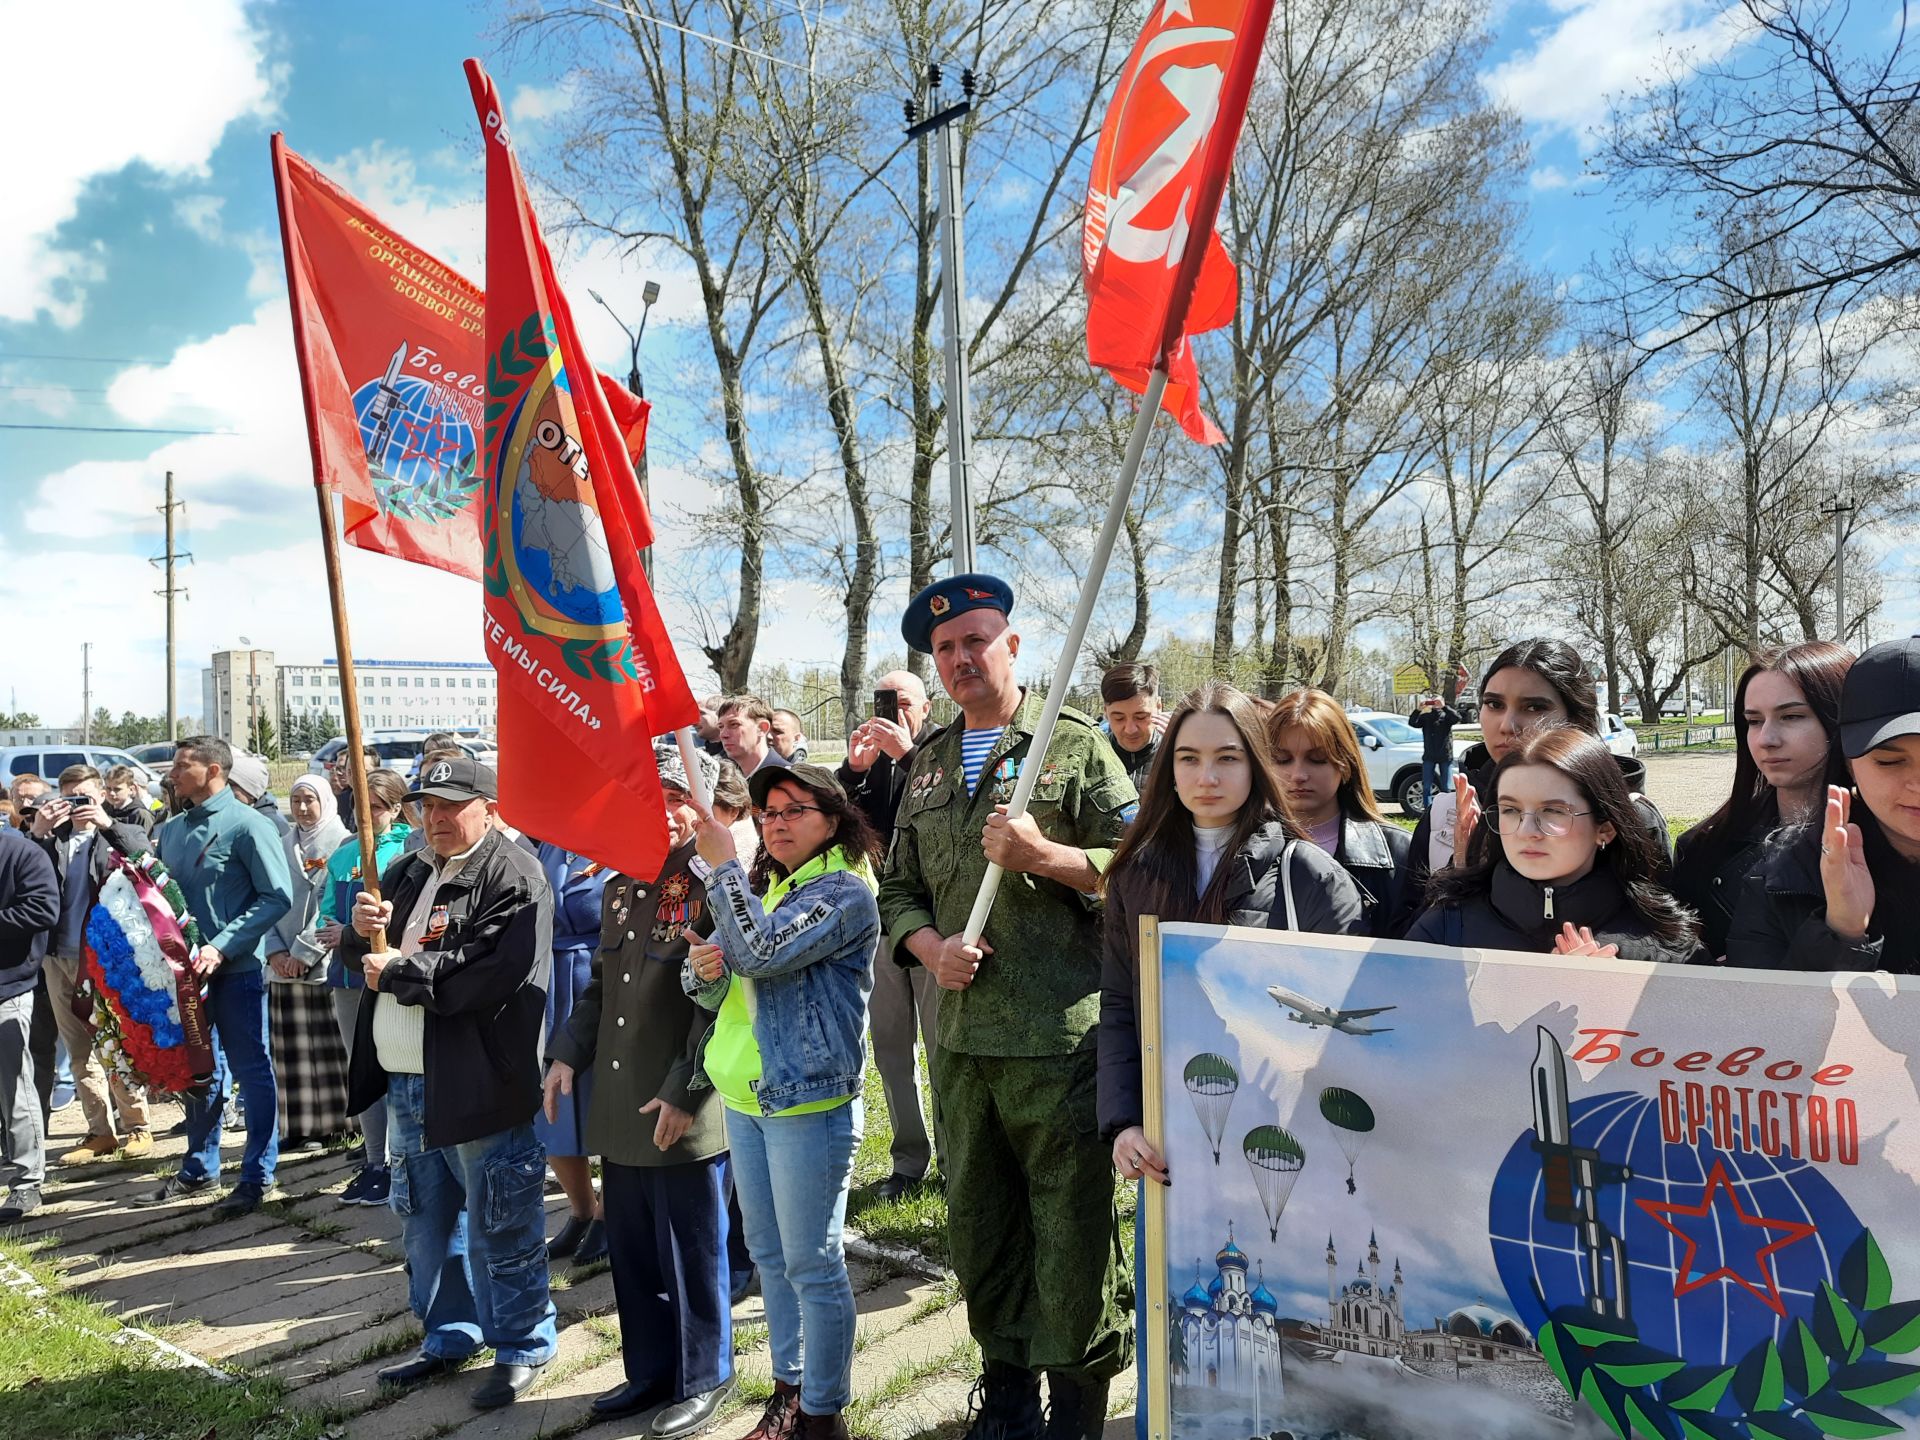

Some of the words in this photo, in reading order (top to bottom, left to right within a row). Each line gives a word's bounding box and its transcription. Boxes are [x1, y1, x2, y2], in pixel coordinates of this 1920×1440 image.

[368, 244, 485, 318] ОРГАНИЗАЦИЯ
[502, 635, 540, 676] МЫ
[536, 668, 601, 730] СИЛА»
[1571, 1028, 1854, 1086] Боевое
[1659, 1079, 1859, 1165] БРАТСТВО
